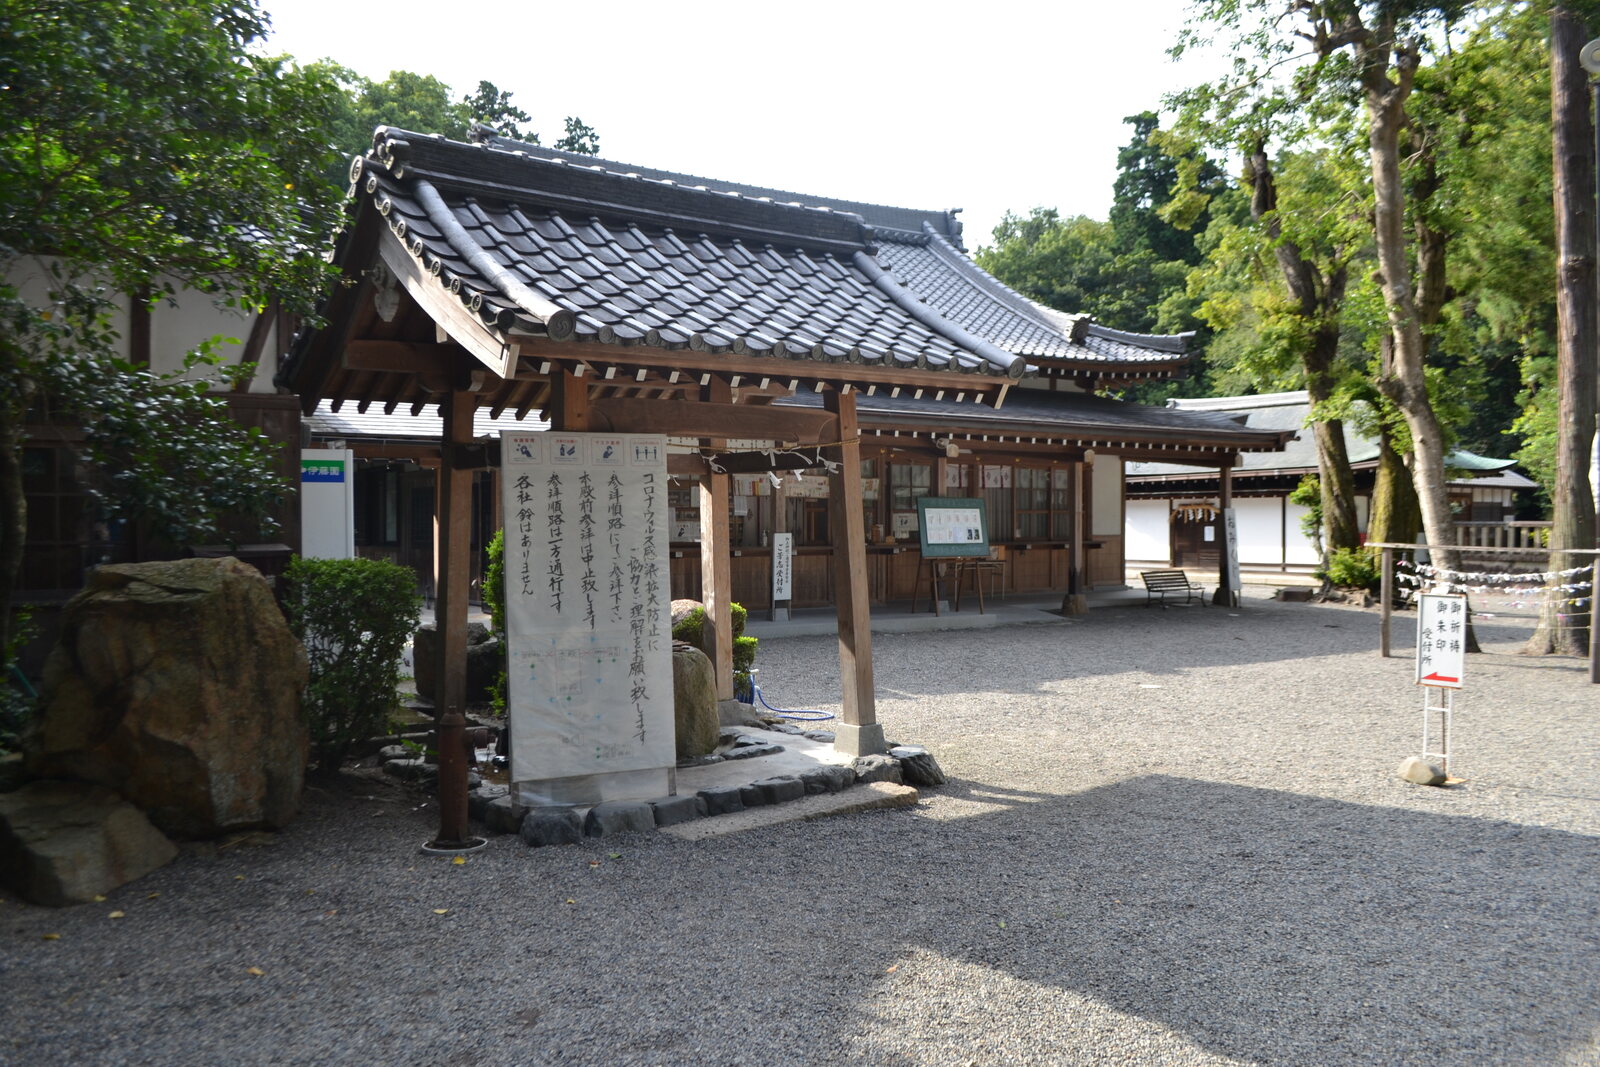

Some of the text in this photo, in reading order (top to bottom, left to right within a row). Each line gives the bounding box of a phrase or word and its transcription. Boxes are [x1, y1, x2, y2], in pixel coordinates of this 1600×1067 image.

[308, 466, 340, 476] 伊藤園
[547, 471, 566, 614] 参拝順路は一方通行です
[578, 471, 599, 630] 本殿前参拝は中止致します
[607, 470, 626, 624] 参拝順路にてご参拝下さい
[626, 548, 649, 746] ご協力とご理解をお願い致します
[1421, 627, 1433, 666] 受付所
[1436, 600, 1448, 652] 御朱印
